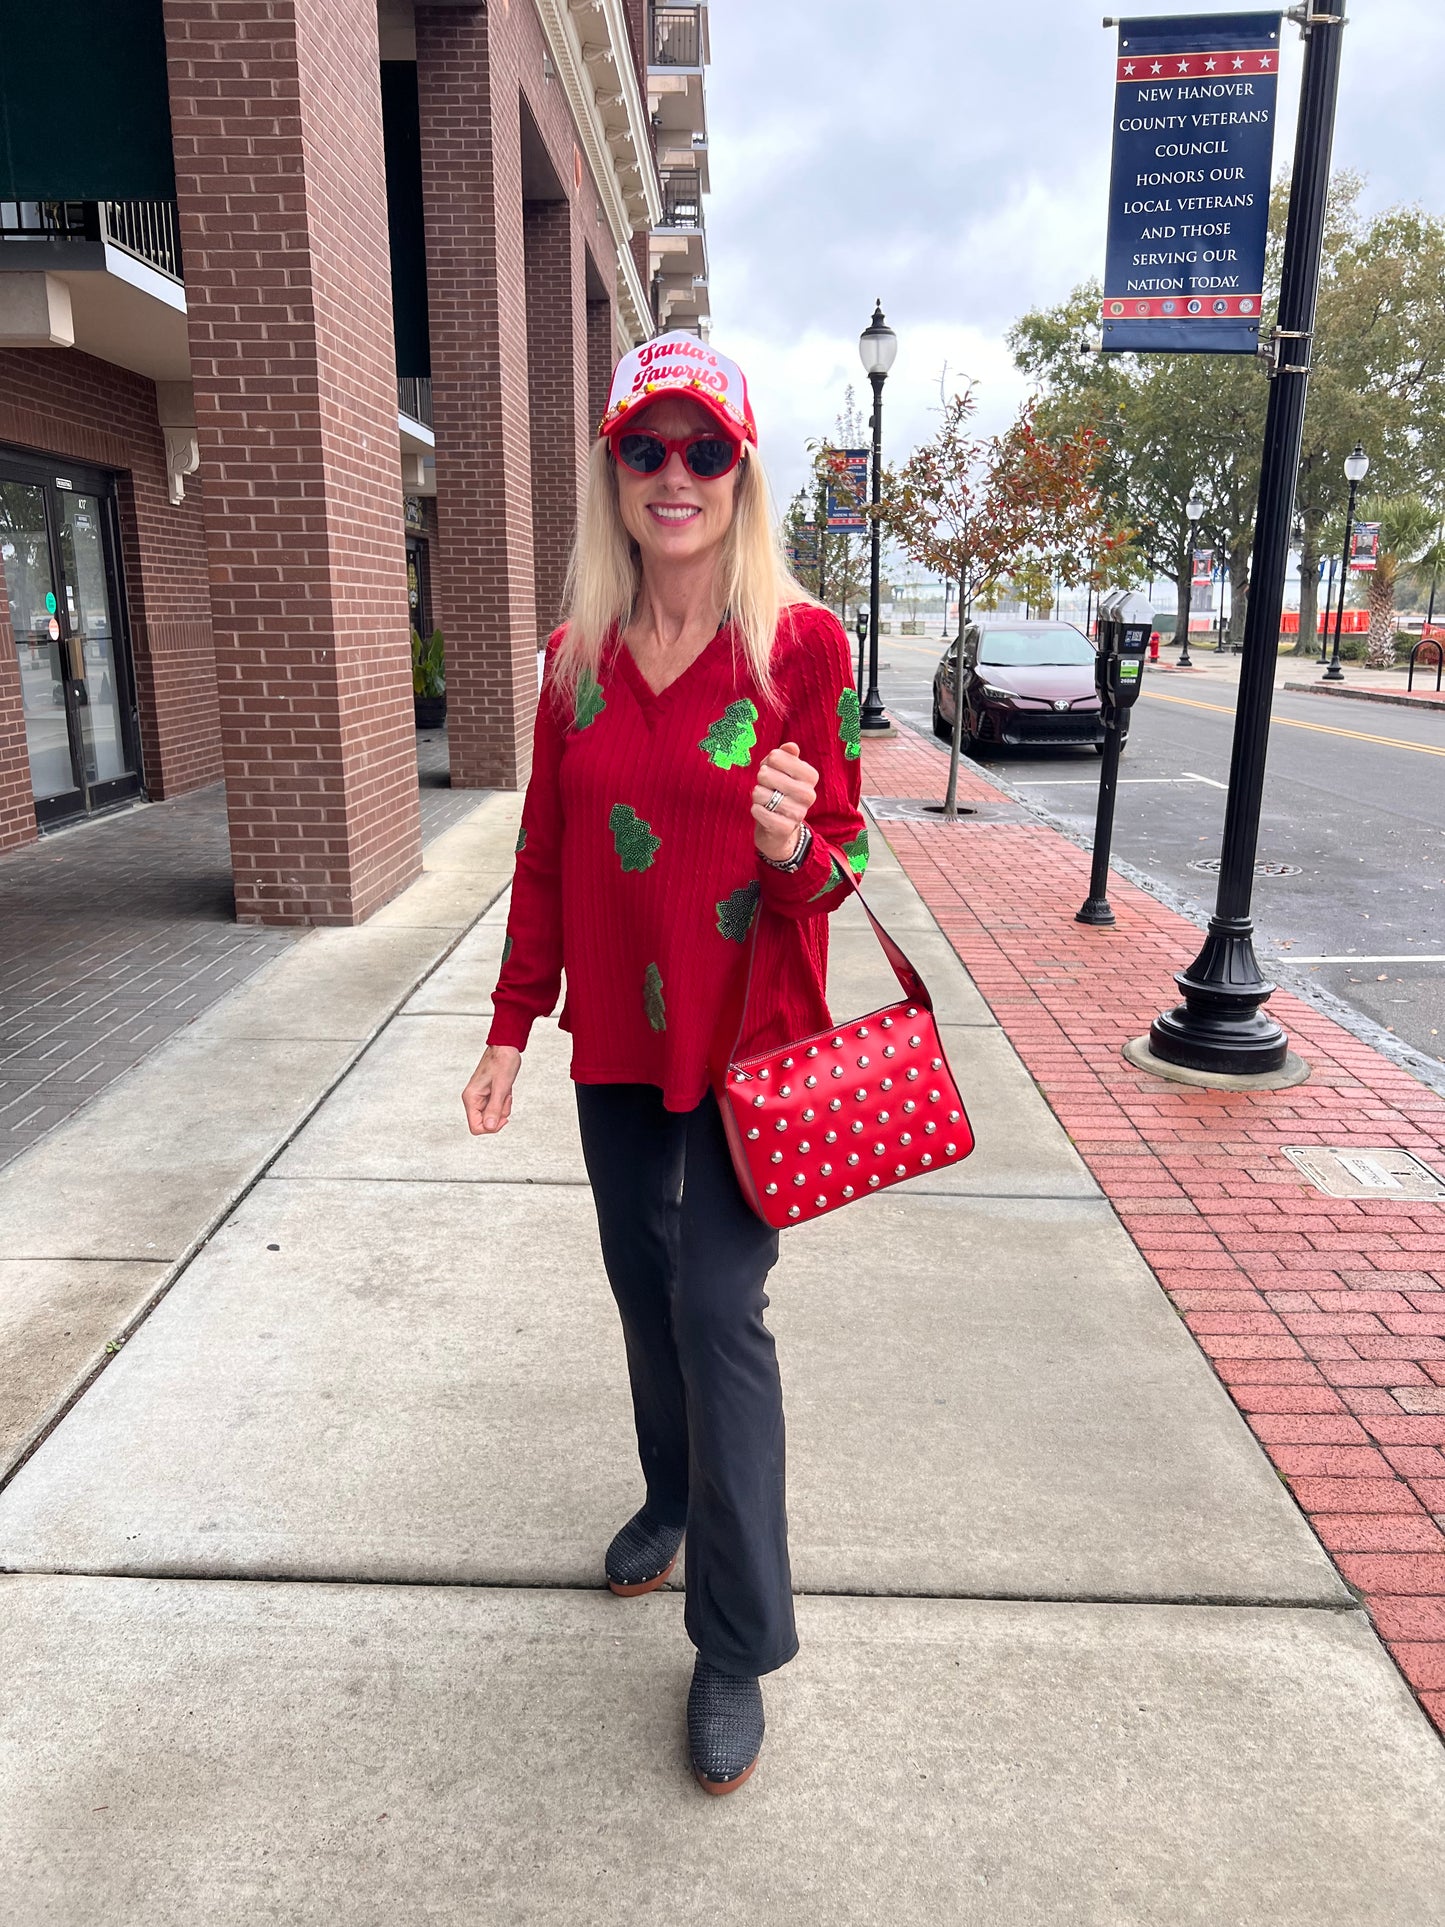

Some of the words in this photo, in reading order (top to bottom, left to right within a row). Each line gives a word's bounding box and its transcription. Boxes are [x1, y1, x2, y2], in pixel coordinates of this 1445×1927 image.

[1138, 88, 1173, 102] NEW
[1177, 83, 1254, 100] HANOVER
[1119, 116, 1187, 131] COUNTY
[1191, 110, 1268, 127] VETERANS
[1155, 140, 1229, 158] COUNCIL
[1136, 170, 1204, 186] HONORS
[1210, 167, 1245, 180] OUR
[1124, 200, 1172, 214] LOCAL
[1177, 194, 1254, 211] VETERANS
[1141, 226, 1175, 239] AND
[1180, 223, 1231, 237] THOSE
[1133, 251, 1197, 266] SERVING
[1202, 249, 1237, 262] OUR
[1127, 277, 1184, 291] NATION
[1189, 275, 1239, 289] TODAY.
[637, 342, 718, 366] Santa's
[632, 365, 728, 392] Favorite
